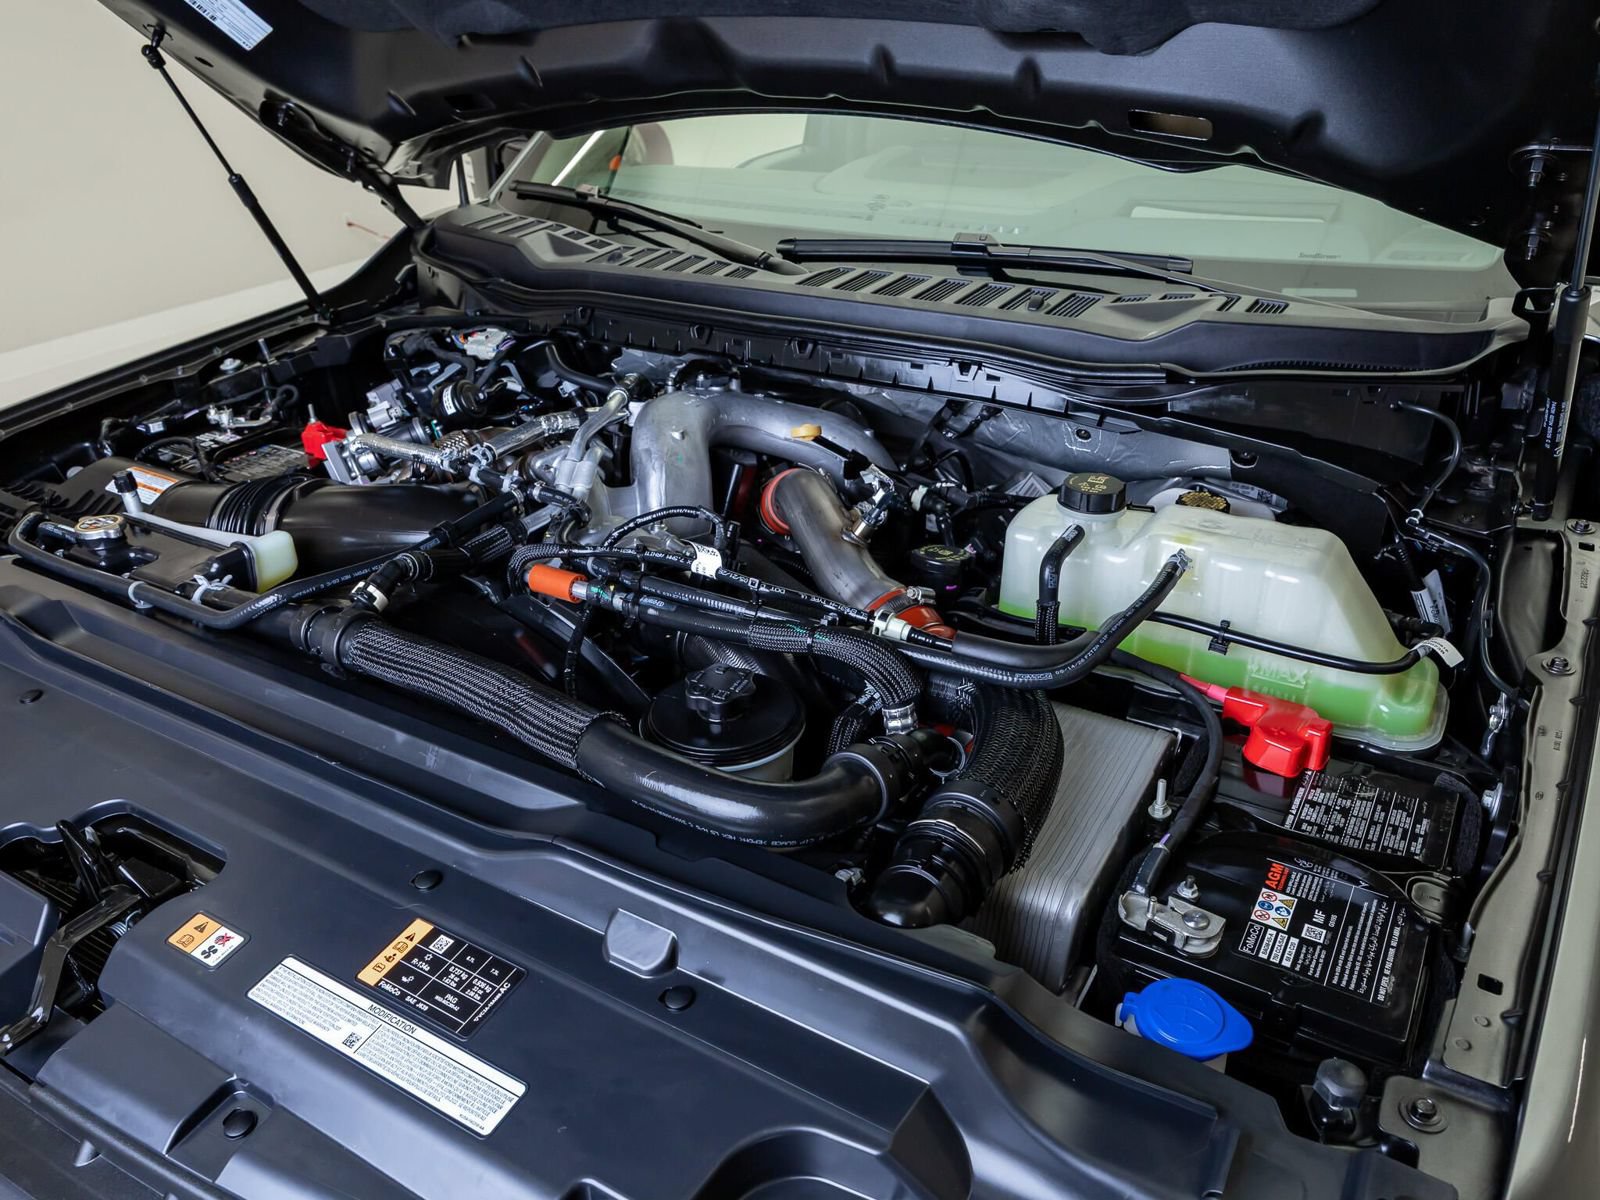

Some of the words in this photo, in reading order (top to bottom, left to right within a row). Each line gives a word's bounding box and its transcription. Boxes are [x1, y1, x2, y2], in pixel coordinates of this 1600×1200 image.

[1263, 861, 1284, 889] AGM
[1311, 908, 1327, 924] MF
[1242, 923, 1261, 953] FoMoCo
[409, 958, 432, 971] R-134a
[377, 980, 402, 996] FoMoCo
[404, 995, 418, 1004] SAE
[443, 993, 459, 1004] PAG
[368, 1004, 417, 1034] MODIFICATION
